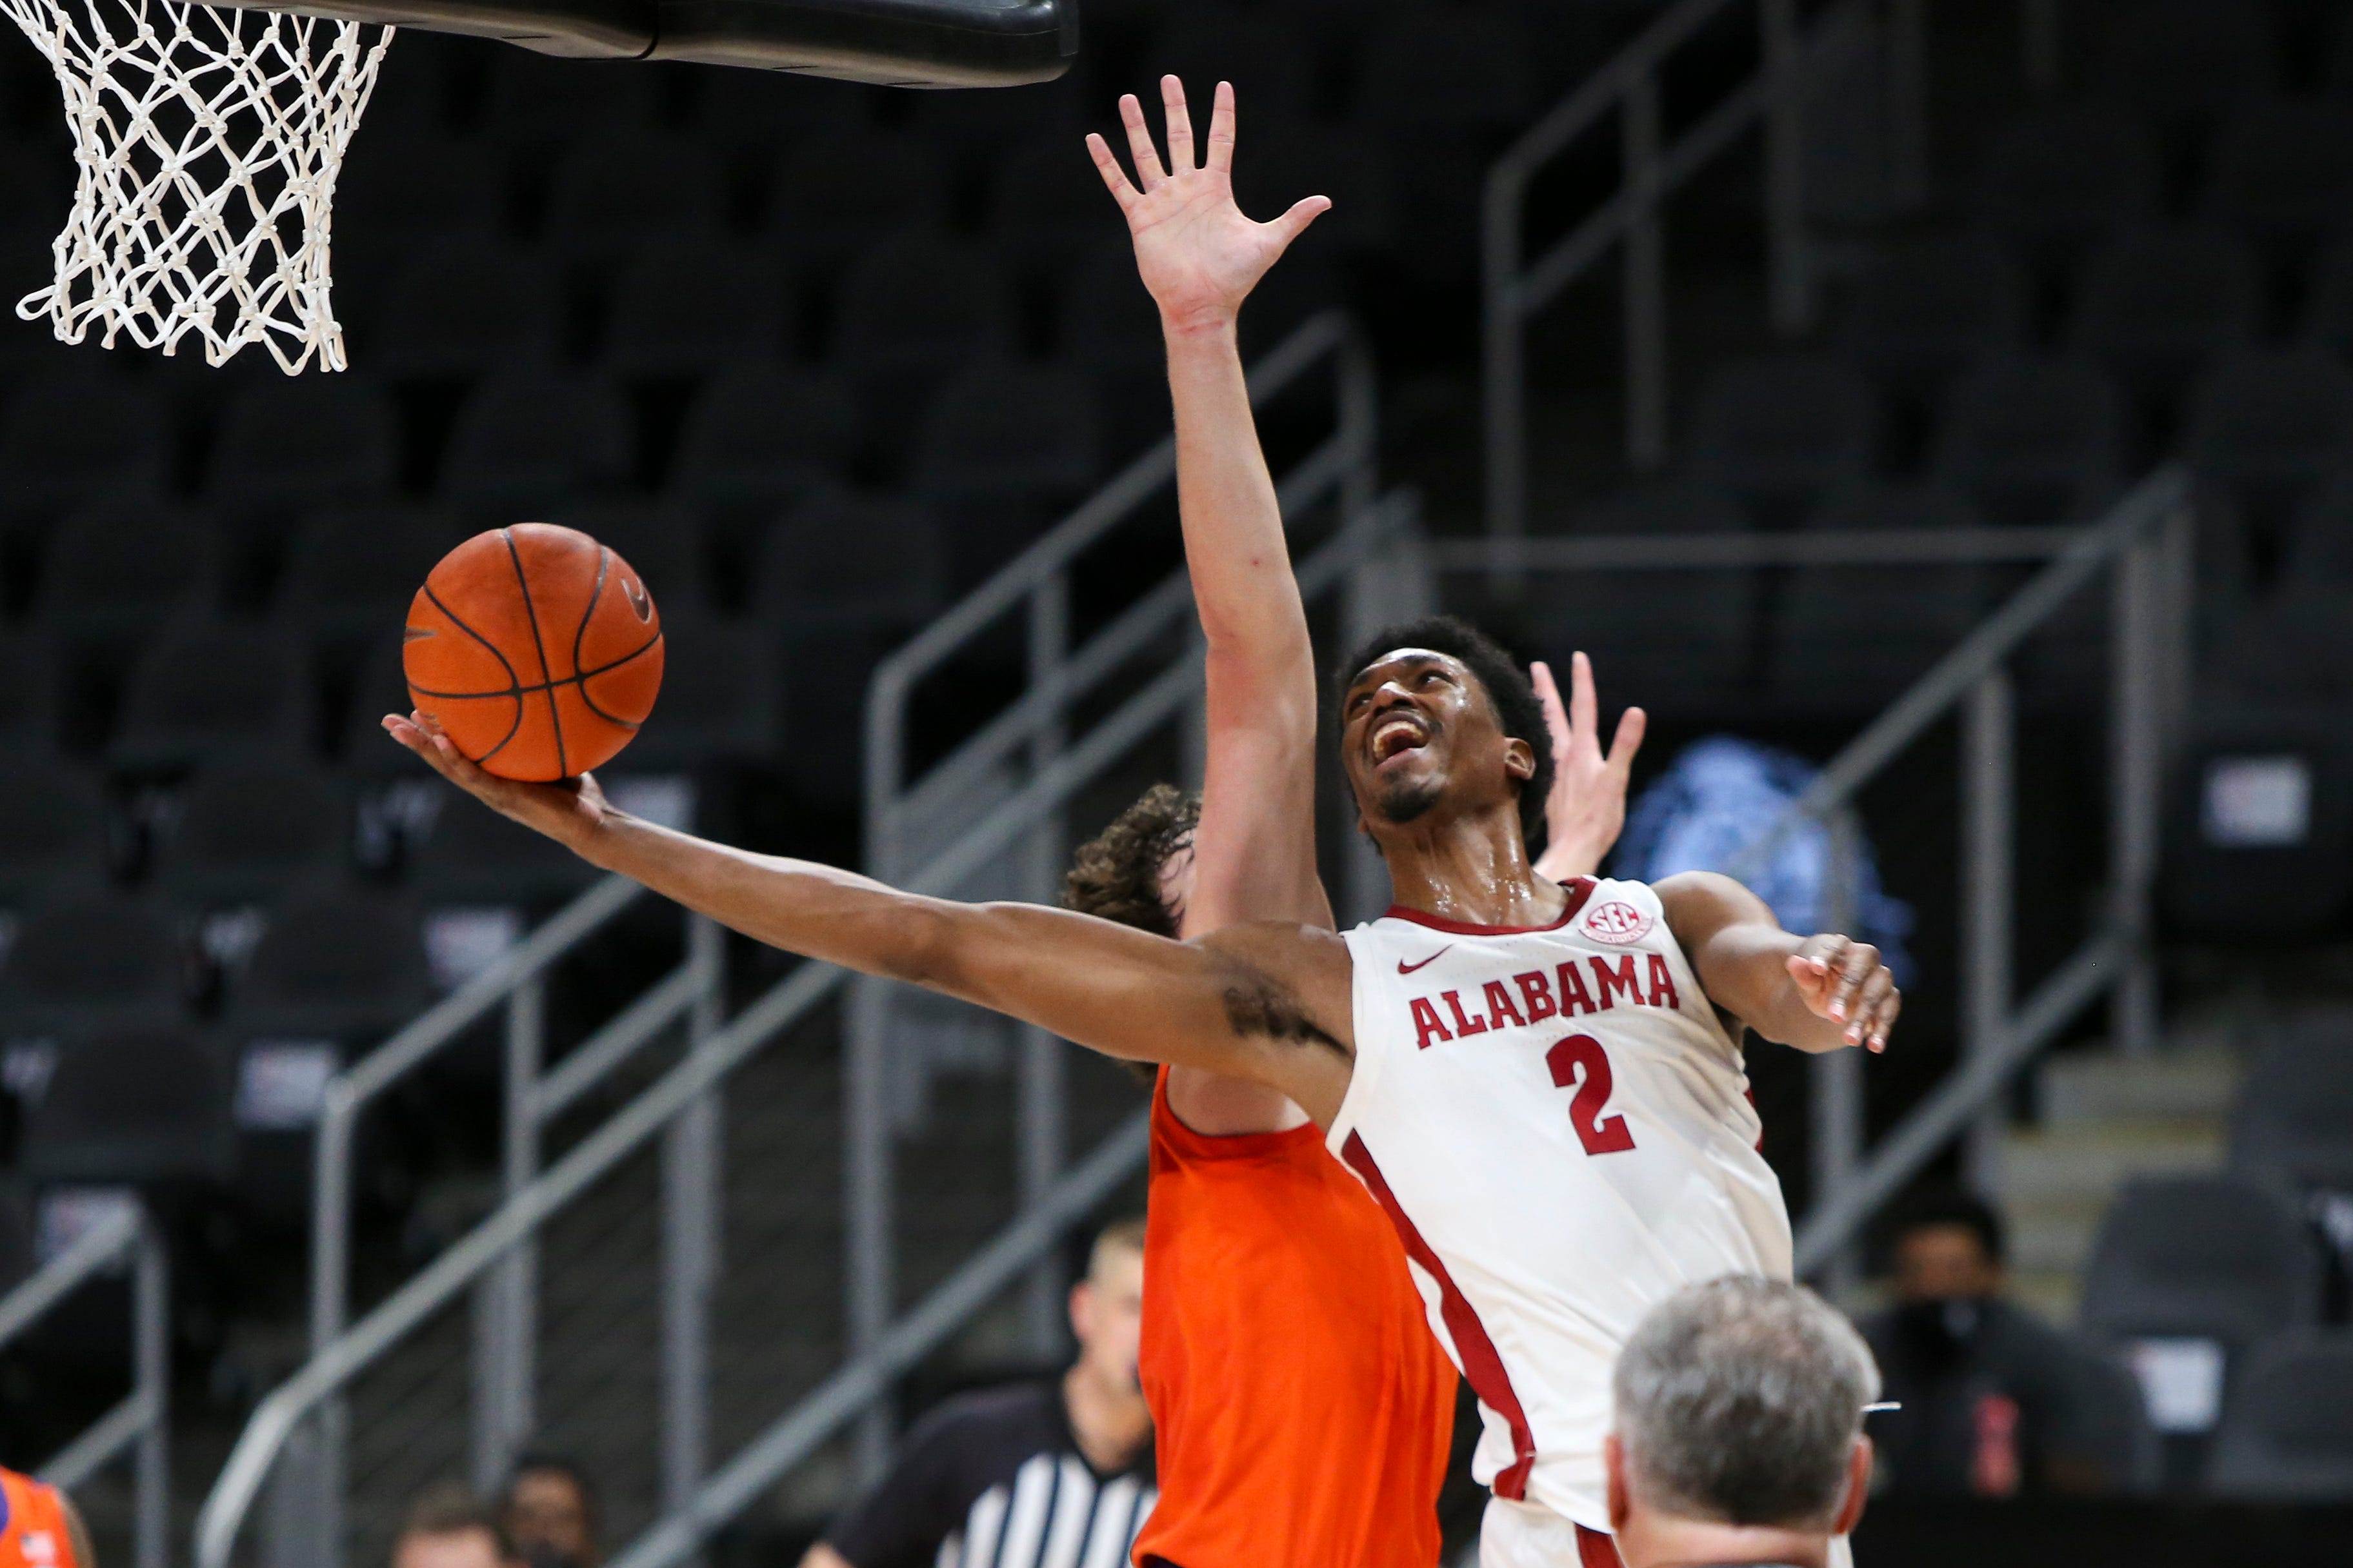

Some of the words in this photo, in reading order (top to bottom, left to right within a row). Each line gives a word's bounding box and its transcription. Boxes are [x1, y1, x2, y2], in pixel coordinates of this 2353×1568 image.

[1587, 903, 1639, 933] SEC
[1409, 954, 1678, 1049] ALABAMA
[1545, 1034, 1636, 1156] 2
